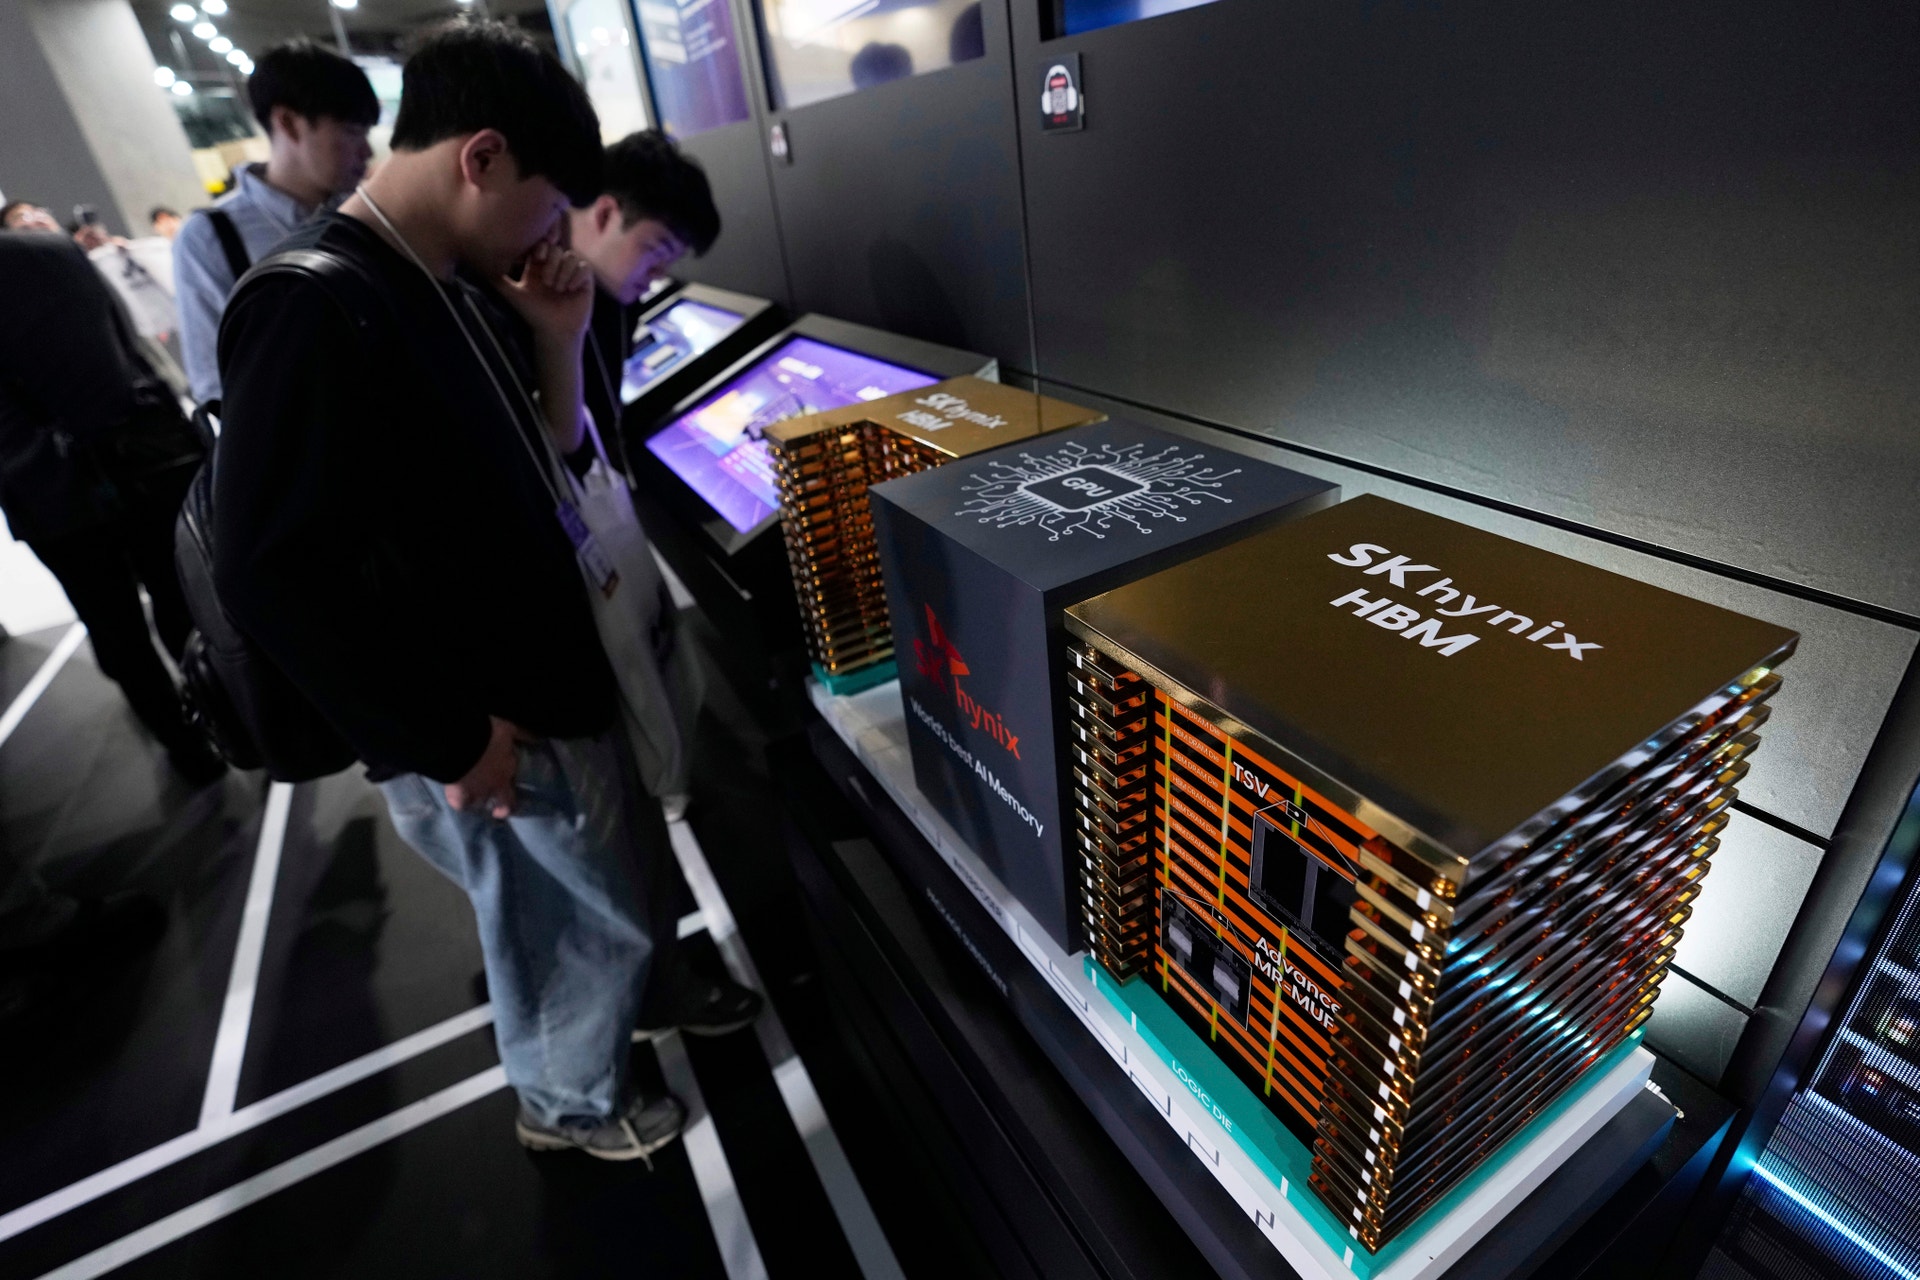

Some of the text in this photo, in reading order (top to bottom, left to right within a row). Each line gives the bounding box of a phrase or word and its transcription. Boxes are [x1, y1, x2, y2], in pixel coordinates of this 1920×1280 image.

[1062, 478, 1113, 497] GPU
[1327, 543, 1604, 661] SK hynix
[1329, 588, 1481, 657] HBM
[954, 676, 1021, 761] hynix
[974, 760, 987, 782] AI
[987, 770, 1044, 838] Memory
[1233, 761, 1270, 798] TSV
[1254, 952, 1335, 1028] MR-MUF
[1172, 1060, 1232, 1133] LOGIC DIE
